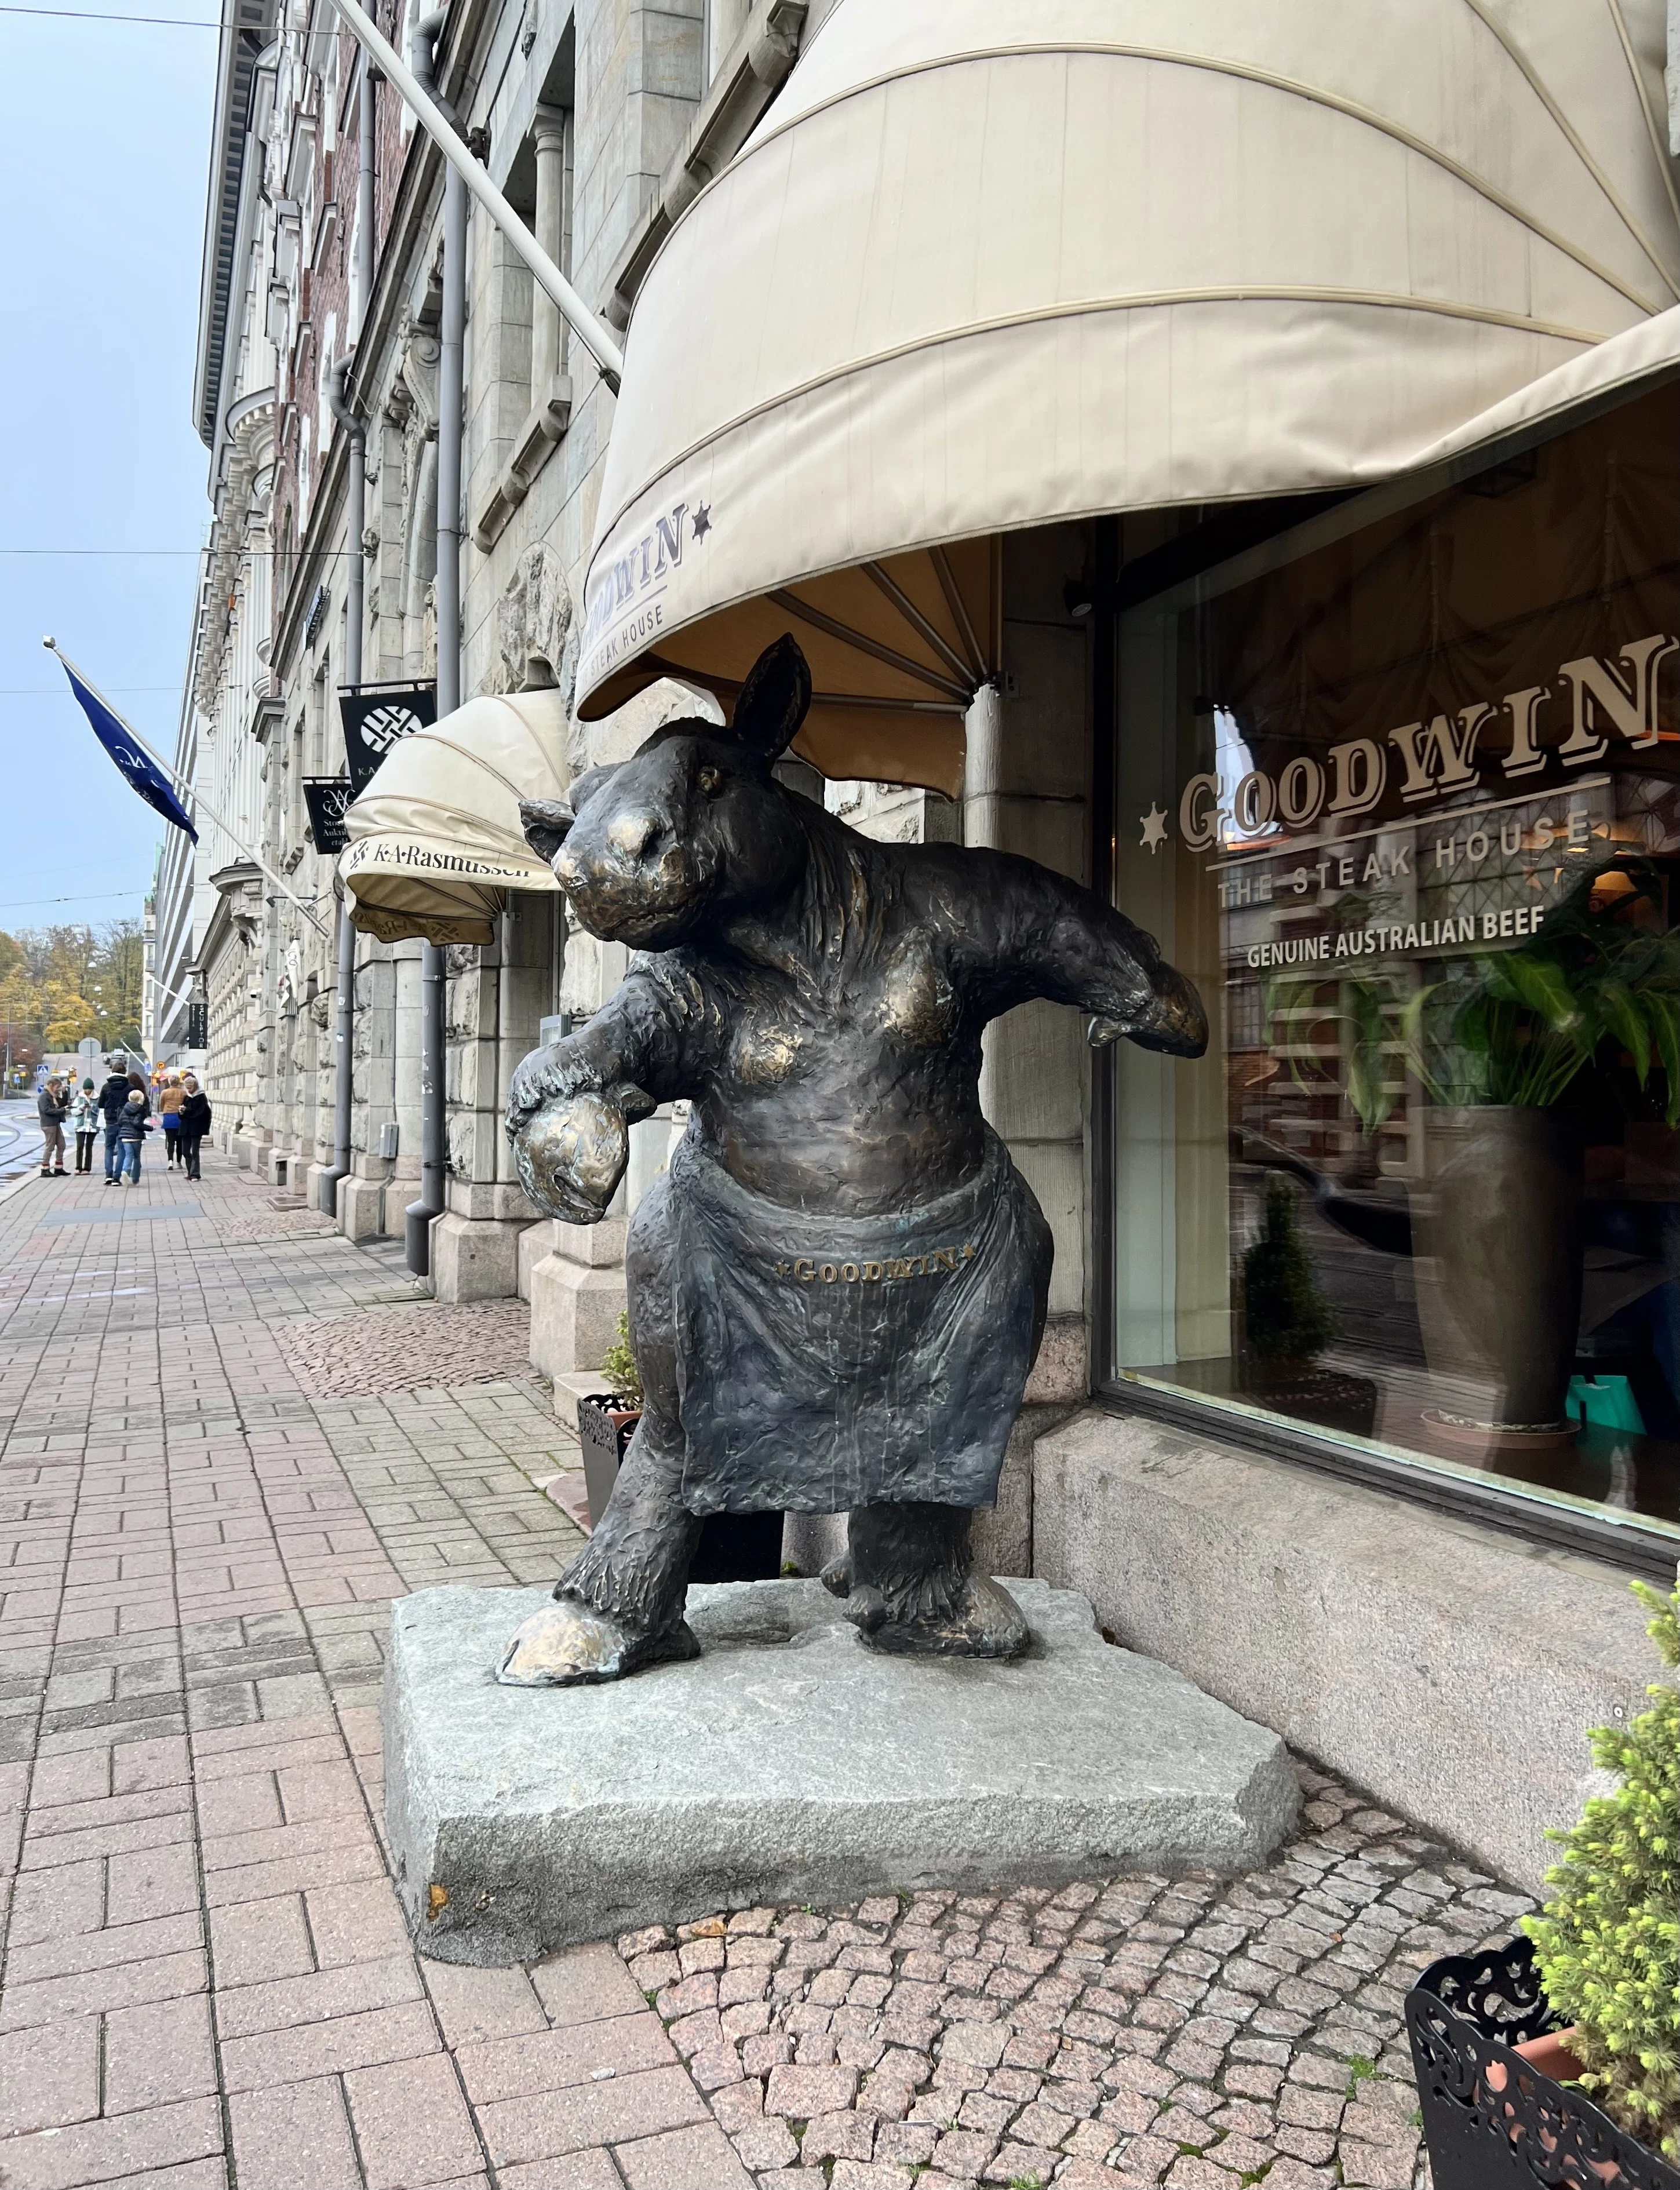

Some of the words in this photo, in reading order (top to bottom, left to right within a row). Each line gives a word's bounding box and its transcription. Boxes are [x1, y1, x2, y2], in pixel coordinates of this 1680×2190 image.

[591, 637, 618, 676] STEAK
[622, 604, 662, 648] HOUSE
[1179, 633, 1679, 852] GOODWIN
[1218, 874, 1273, 908] THE
[1293, 846, 1411, 894] STEAK
[1435, 809, 1589, 868] HOUSE
[1247, 935, 1330, 968] GENUINE
[1335, 915, 1475, 957] AUSTRALIAN
[1482, 905, 1544, 939] BEEF
[793, 1247, 959, 1284] GOODWIN
